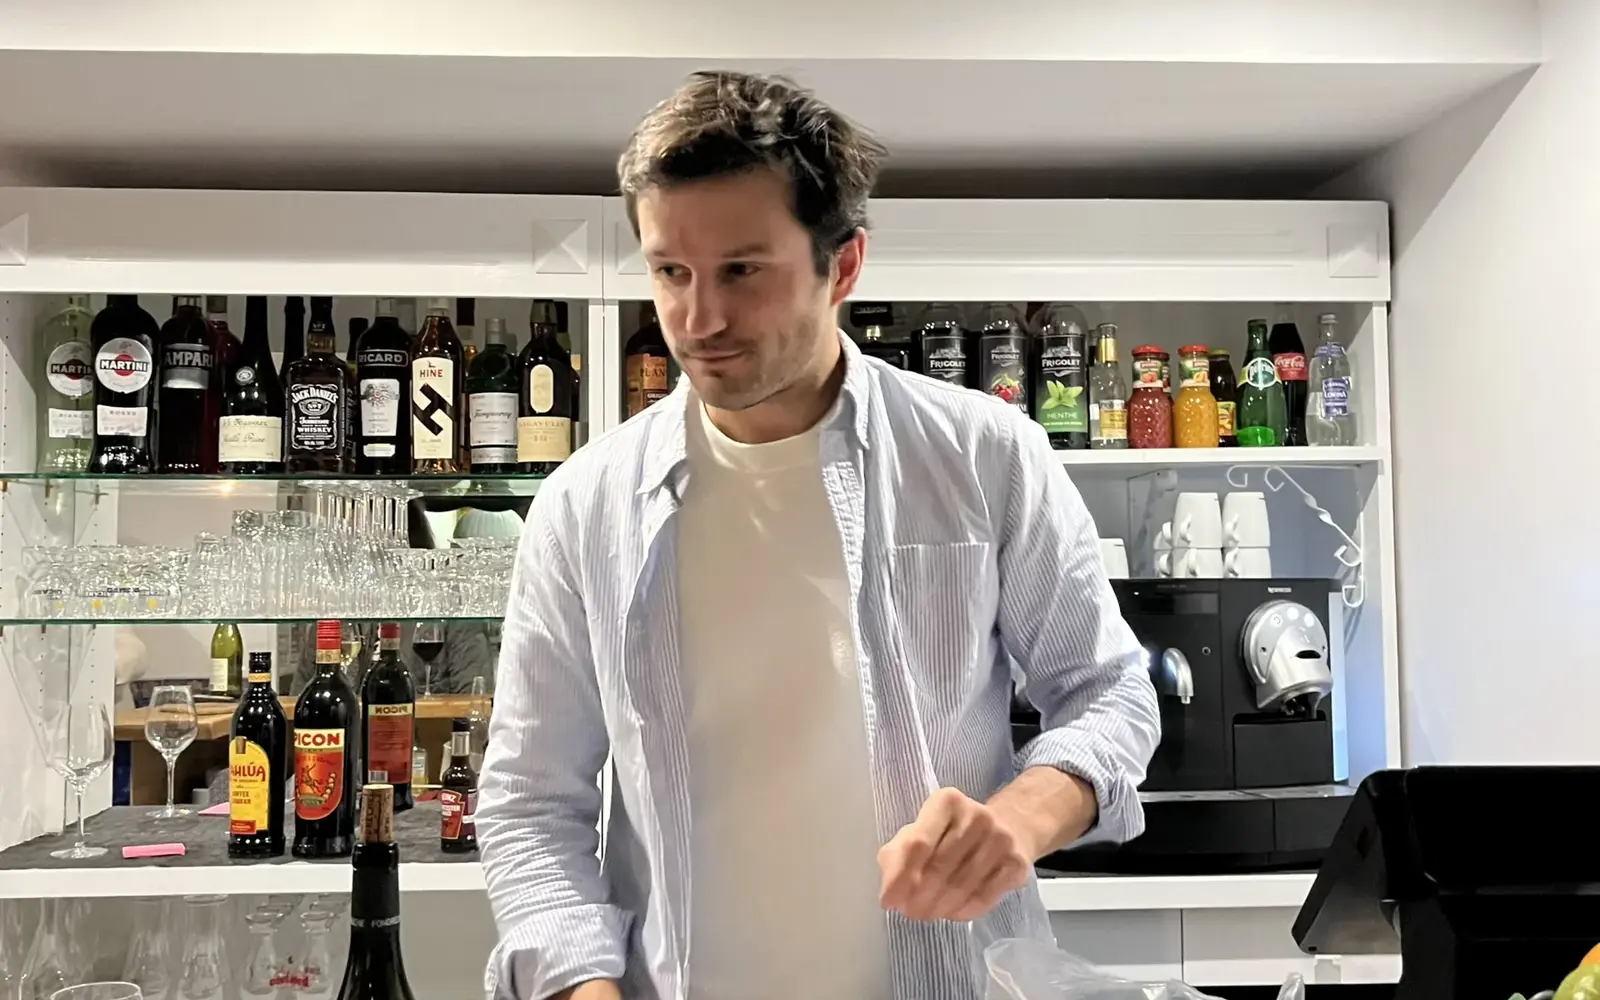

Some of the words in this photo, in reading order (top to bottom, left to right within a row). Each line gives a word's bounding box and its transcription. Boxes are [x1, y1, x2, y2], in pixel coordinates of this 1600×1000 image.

[164, 351, 213, 367] AMPARI
[358, 353, 403, 363] RICARD
[1042, 359, 1080, 367] FRIGOLET
[1274, 355, 1304, 368] Coca-Cola
[51, 364, 92, 374] MARTIN
[100, 360, 149, 372] MARTINI
[930, 360, 966, 368] FRIGOLET
[419, 369, 443, 377] HINE
[1047, 411, 1078, 419] MENTHE
[231, 761, 266, 782] AHLÚA
